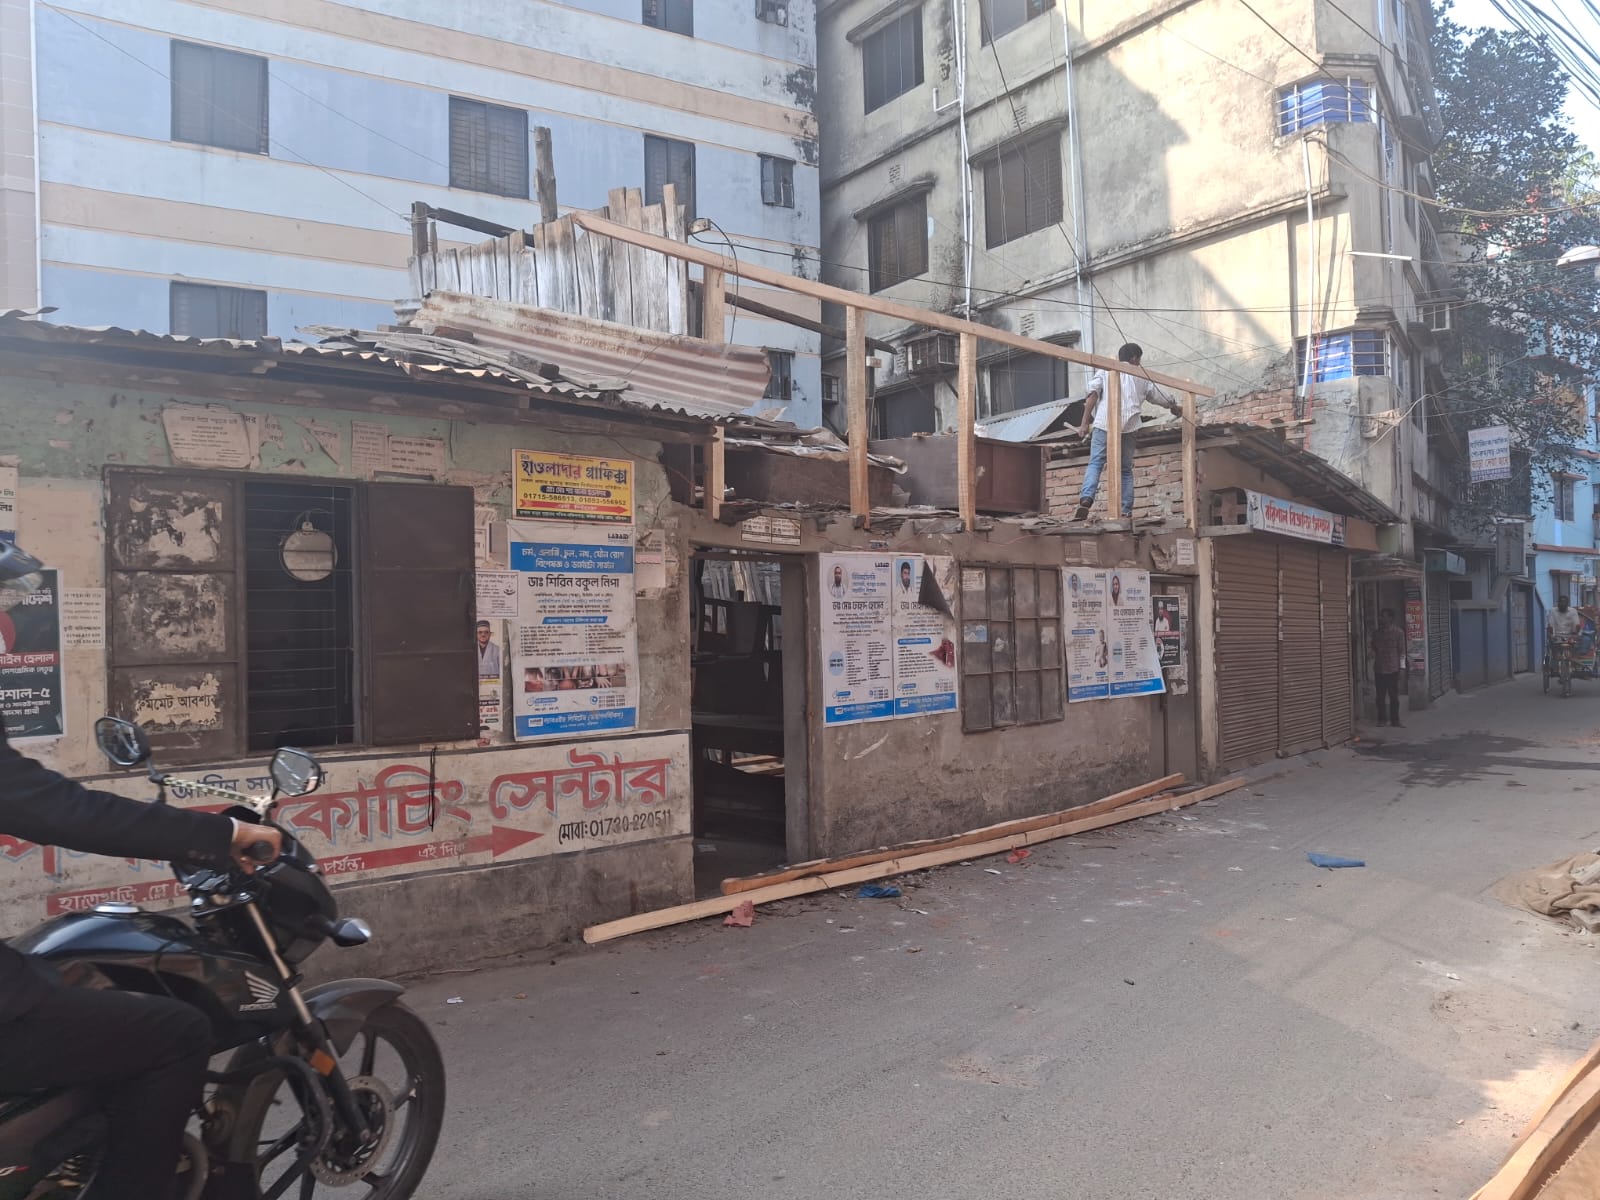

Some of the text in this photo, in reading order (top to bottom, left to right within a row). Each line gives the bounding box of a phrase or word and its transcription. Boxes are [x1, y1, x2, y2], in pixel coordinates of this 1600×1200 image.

[521, 460, 627, 484] হাওলাদার গ্রাফিক্স
[563, 561, 570, 569] ও
[528, 573, 620, 591] ডাঃ শিরিন বকুল নিপা
[24, 653, 55, 665] হেলাল
[272, 747, 673, 843] কোচিং সেন্টার
[418, 844, 438, 858] এই
